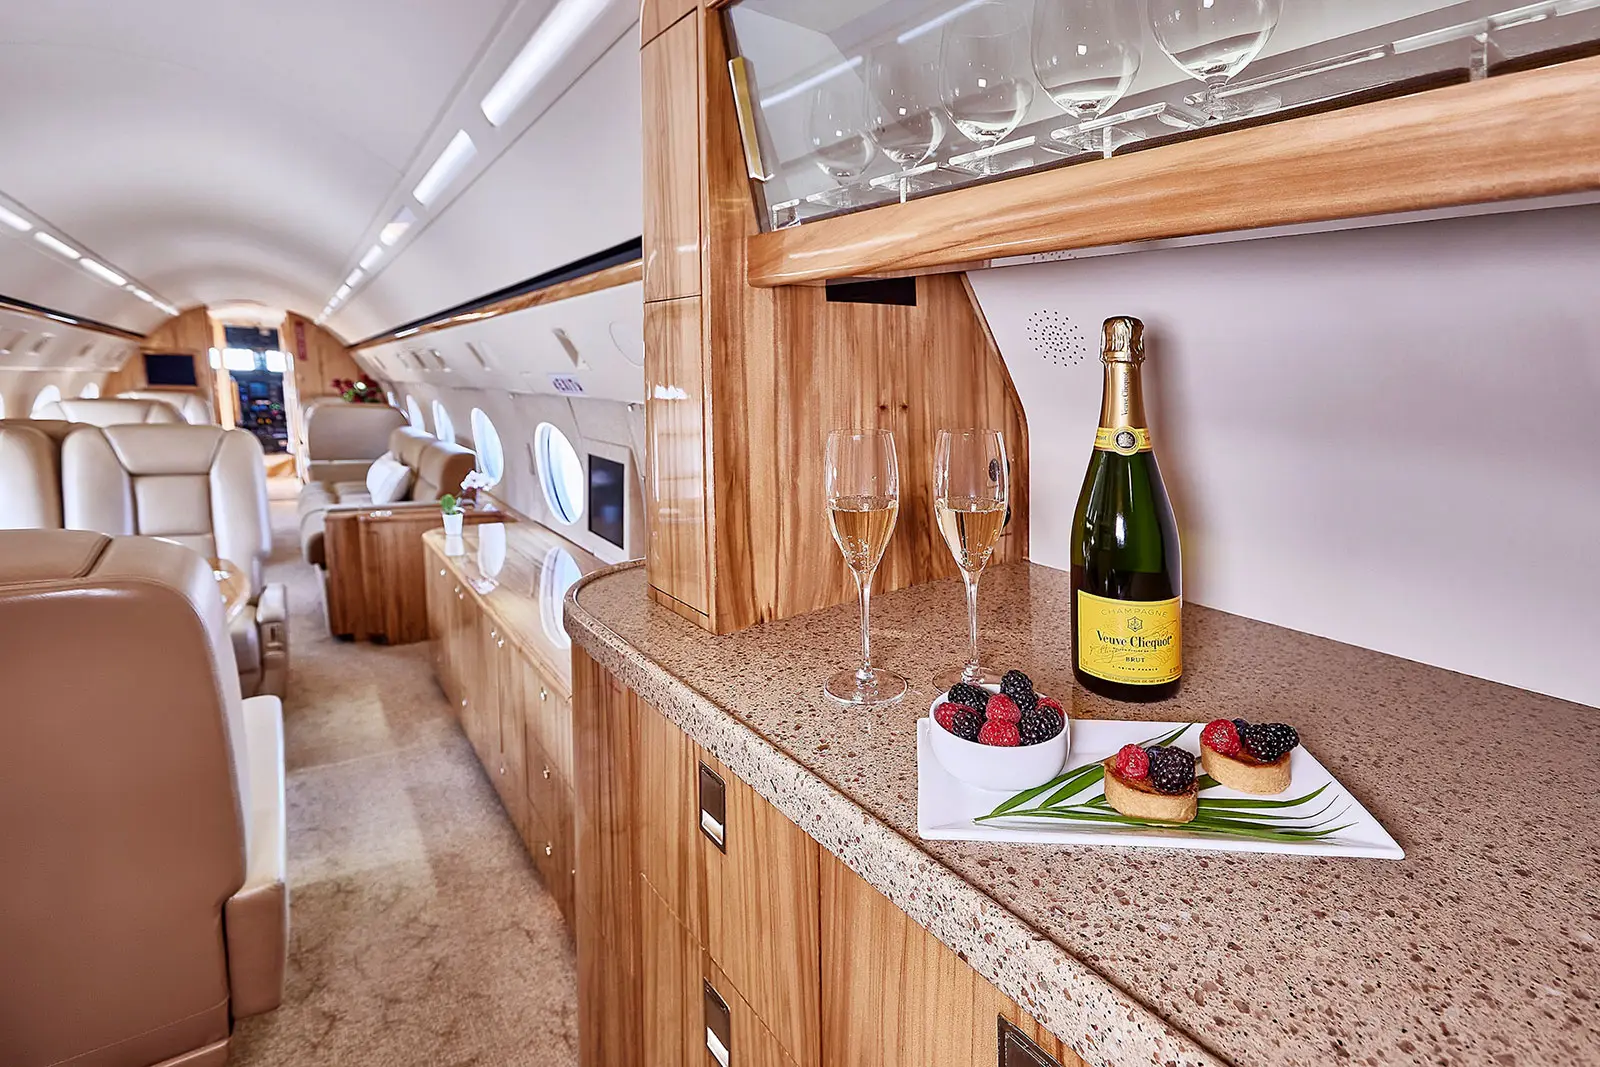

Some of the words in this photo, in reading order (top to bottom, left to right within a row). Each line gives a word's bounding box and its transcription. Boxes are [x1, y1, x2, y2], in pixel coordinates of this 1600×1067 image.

[1101, 608, 1168, 618] CHAMPAGNE
[1096, 630, 1127, 646] Veuve
[1130, 635, 1172, 649] Clicquot
